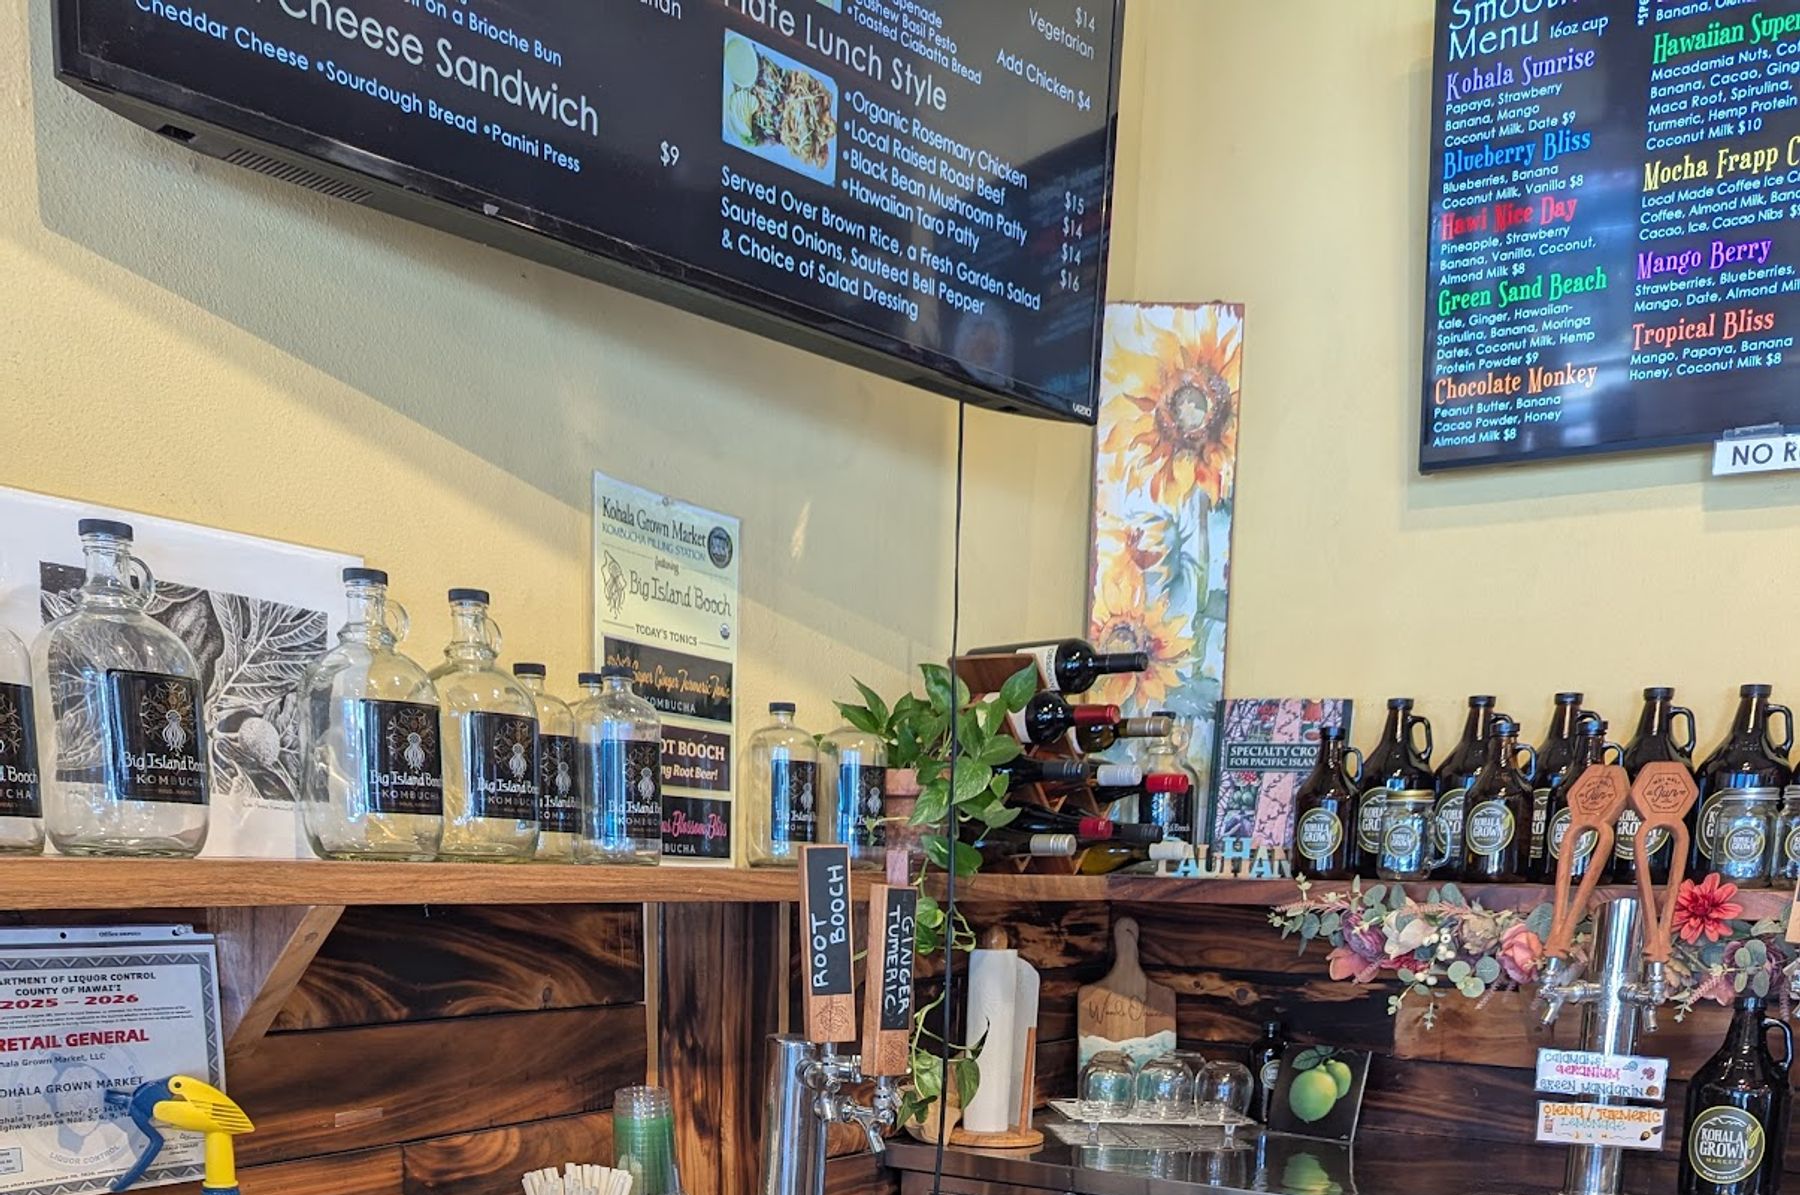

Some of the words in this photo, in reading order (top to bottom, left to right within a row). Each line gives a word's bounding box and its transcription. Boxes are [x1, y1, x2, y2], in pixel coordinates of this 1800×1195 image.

[452, 10, 463, 25] a
[469, 12, 529, 52] Brioche
[534, 40, 562, 67] Bun
[900, 13, 926, 38] Basil
[929, 28, 957, 53] Pesto
[1029, 7, 1094, 60] Vegetarian
[1075, 7, 1095, 32] $14
[1449, 20, 1539, 62] Menu
[1550, 21, 1578, 39] 16oz
[1582, 16, 1609, 37] cup
[806, 14, 882, 81] Lunch
[891, 58, 947, 111] Style
[852, 6, 898, 42] Toasted
[900, 27, 948, 67] Ciabatta
[951, 55, 982, 84] Bread
[1653, 22, 1744, 65] Hawaiian
[277, 0, 424, 65] Cheese
[436, 37, 599, 136] Sandwich
[996, 48, 1023, 76] Add
[1026, 64, 1074, 103] Chicken
[1077, 91, 1091, 112] $4
[1446, 62, 1514, 102] Kohala
[1521, 48, 1595, 86] Sunrise
[235, 26, 309, 71] Cheese
[325, 61, 423, 114] Sourdough
[428, 99, 477, 135] Bread
[492, 124, 539, 158] Panini
[544, 143, 581, 173] Press
[852, 91, 909, 134] Organic
[912, 119, 976, 168] Rosemary
[978, 151, 1028, 189] Chicken
[1444, 127, 1496, 148] Coconut
[1528, 115, 1558, 132] Date
[1562, 110, 1576, 127] $9
[1646, 130, 1705, 151] Coconut
[1708, 123, 1734, 139] Milk
[1737, 117, 1762, 136] $10
[660, 141, 680, 166] $9
[851, 120, 889, 153] Local
[893, 139, 936, 175] Raised
[940, 160, 975, 192] Roast
[977, 177, 1006, 206] Beef
[1443, 142, 1537, 181] Blueberry
[1543, 129, 1591, 161] Bliss
[1643, 154, 1709, 192] Mocha
[1716, 146, 1779, 180] Frapp
[849, 178, 913, 222] Hawaiian
[916, 207, 944, 235] Taro
[947, 221, 980, 253] Patty
[850, 149, 888, 182] Black
[891, 168, 925, 198] Bean
[929, 185, 993, 229] Mushroom
[997, 213, 1027, 246] Patty
[1065, 191, 1084, 215] $15
[1494, 202, 1534, 233] Nice
[1540, 196, 1578, 226] Day
[721, 165, 776, 205] Served
[781, 191, 818, 221] Over
[822, 207, 865, 241] Brown
[870, 226, 903, 257] Rice,
[907, 245, 917, 260] a
[920, 247, 953, 276] Fresh
[956, 262, 1004, 296] Garden
[1007, 282, 1040, 311] Salad
[1063, 216, 1083, 240] $14
[721, 196, 788, 240] Sauteed
[792, 225, 847, 264] Onions,
[851, 247, 908, 286] Sauteed
[913, 274, 934, 296] Bell
[939, 282, 985, 315] Pepper
[1061, 243, 1081, 266] $14
[1637, 249, 1702, 280] Mango
[1710, 239, 1772, 270] Berry
[721, 229, 733, 250] &
[738, 234, 794, 271] Choice
[800, 260, 814, 279] of
[818, 264, 858, 296] Salad
[863, 281, 919, 322] Dressing
[1060, 269, 1079, 292] $16
[1438, 288, 1492, 317] Green
[1498, 275, 1542, 308] Sand
[1550, 266, 1607, 302] Beach
[1632, 313, 1716, 351] Tropical
[1722, 308, 1775, 340] Bliss
[1435, 371, 1521, 405] Chocolate
[1527, 362, 1598, 395] Monkey
[1436, 360, 1476, 376] Protein
[1478, 355, 1522, 371] Powder
[1525, 351, 1540, 366] $9
[1731, 442, 1773, 467] NO
[602, 496, 635, 527] Kohala
[636, 509, 669, 537] Grown
[672, 520, 706, 547] Market
[630, 570, 650, 601] Big
[651, 577, 692, 608] Island
[694, 585, 732, 617] Booch
[635, 623, 668, 641] TODAY'S
[670, 631, 698, 646] TONICS
[123, 751, 145, 770] Big
[147, 752, 187, 772] Island
[678, 741, 726, 761] BOOCH
[1229, 745, 1290, 757] SPECIALTY
[1290, 745, 1320, 757] CRO
[1229, 757, 1249, 766] FOR
[1250, 757, 1288, 767] PACIFIC
[1288, 757, 1316, 767] ISLAN
[8, 765, 38, 784] Booch
[370, 770, 389, 787] Big
[390, 770, 425, 788] Island
[673, 764, 694, 779] Root
[695, 766, 718, 781] Beer!
[811, 912, 829, 988] ROOT
[827, 864, 847, 945] BOOCH
[884, 904, 901, 1010] TUMERIC
[897, 915, 914, 1015] GINGER
[15, 987, 58, 996] COUNTY
[61, 986, 75, 994] OF
[51, 975, 65, 984] OF
[68, 973, 108, 984] LIQUOR
[110, 971, 156, 982] CONTROL
[0, 998, 59, 1010] 2025
[84, 993, 139, 1006] 2026
[0, 1035, 62, 1052] RETAIL
[65, 1028, 150, 1047] GENERAL
[21, 1058, 52, 1067] Grown
[90, 1053, 106, 1061] LLC
[46, 1083, 93, 1094] GROWN
[96, 1076, 144, 1089] MARKET
[1699, 1140, 1748, 1159] GROWN
[1701, 1127, 1745, 1143] KOHALA
